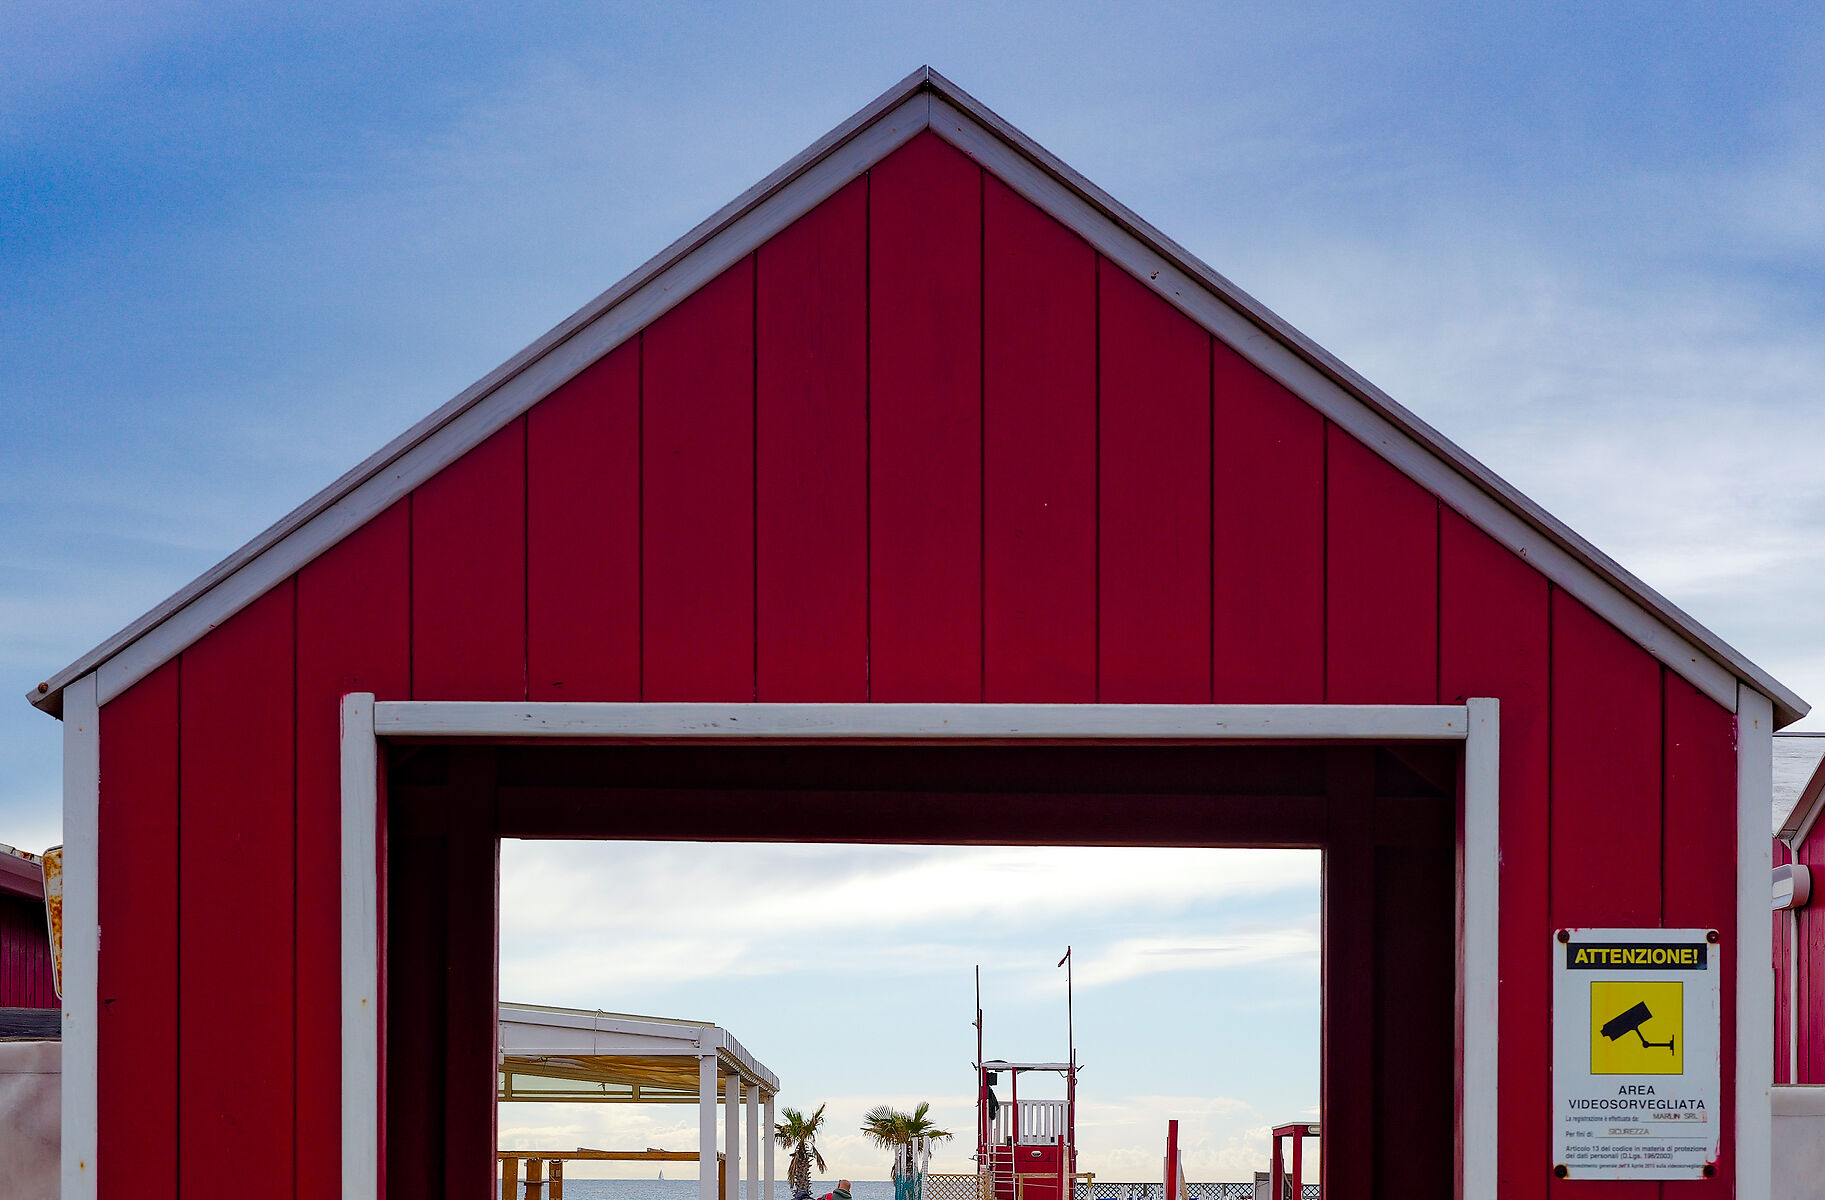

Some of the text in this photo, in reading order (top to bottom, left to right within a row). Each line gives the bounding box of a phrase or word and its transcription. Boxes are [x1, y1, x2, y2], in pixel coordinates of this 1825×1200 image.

[1575, 949, 1698, 964] ATTENZIONE!
[1618, 1085, 1656, 1095] AREA
[1568, 1099, 1706, 1110] VIDEOSORVEGLIATA
[1674, 1145, 1707, 1153] protezione
[1590, 1152, 1618, 1160] personali
